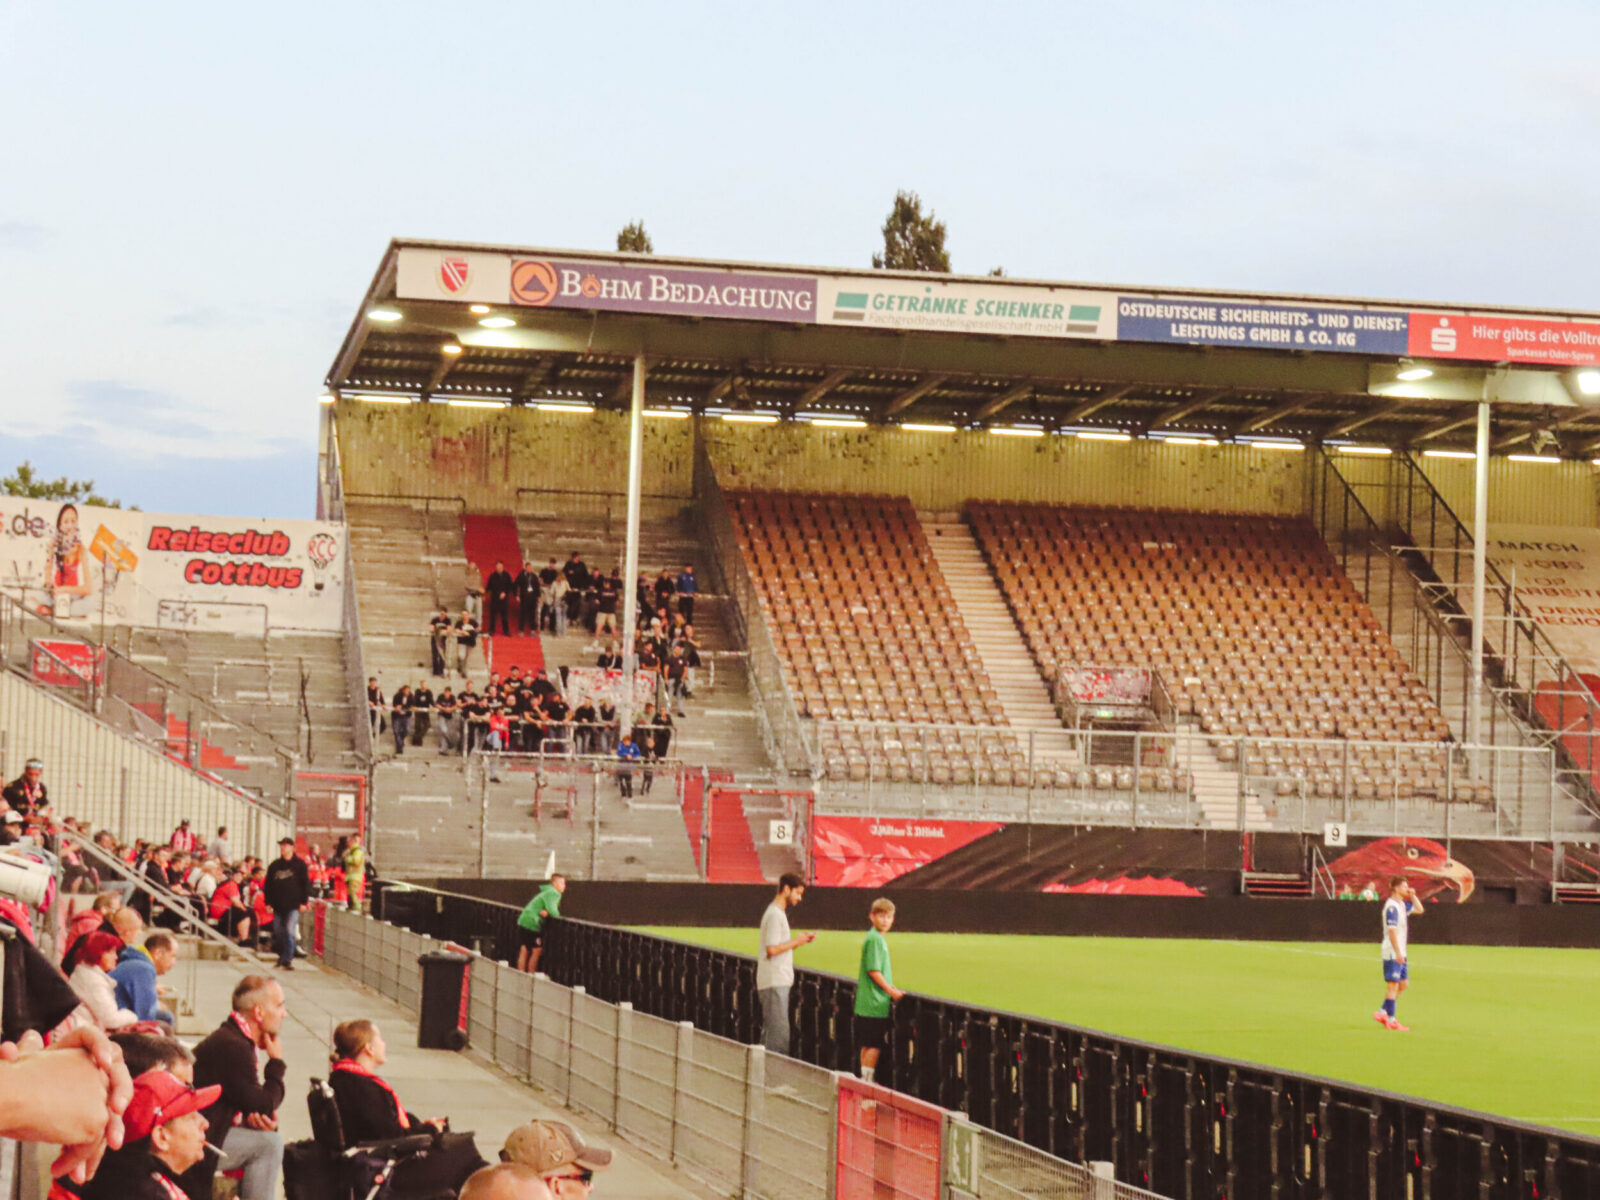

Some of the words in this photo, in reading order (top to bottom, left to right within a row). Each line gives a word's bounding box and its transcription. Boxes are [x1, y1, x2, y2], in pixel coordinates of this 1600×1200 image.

[649, 275, 813, 311] BEDACHUNG
[975, 298, 1065, 321] SCHENKER
[1119, 302, 1217, 321] OSTDEUTSCHE
[1220, 307, 1315, 327] SICHERHEITS-
[1318, 312, 1349, 329] UND
[1353, 315, 1408, 331] DIENST-
[1034, 321, 1064, 334] mbH
[1170, 322, 1246, 340] LEISTUNGS
[1249, 327, 1292, 343] GMBH
[1294, 329, 1305, 343] &
[1308, 330, 1333, 345] CO.
[1336, 332, 1357, 347] KG
[1472, 325, 1501, 340] Hier
[1502, 327, 1537, 344] gibts
[1539, 329, 1560, 344] die
[1506, 347, 1548, 359] Sparkasse
[0, 508, 46, 538] .de
[147, 525, 290, 557] Reiseclub
[307, 538, 337, 559] RCC
[184, 559, 303, 589] Cottbus
[343, 800, 350, 813] 7
[776, 825, 786, 840] 8
[1331, 827, 1340, 841] 9
